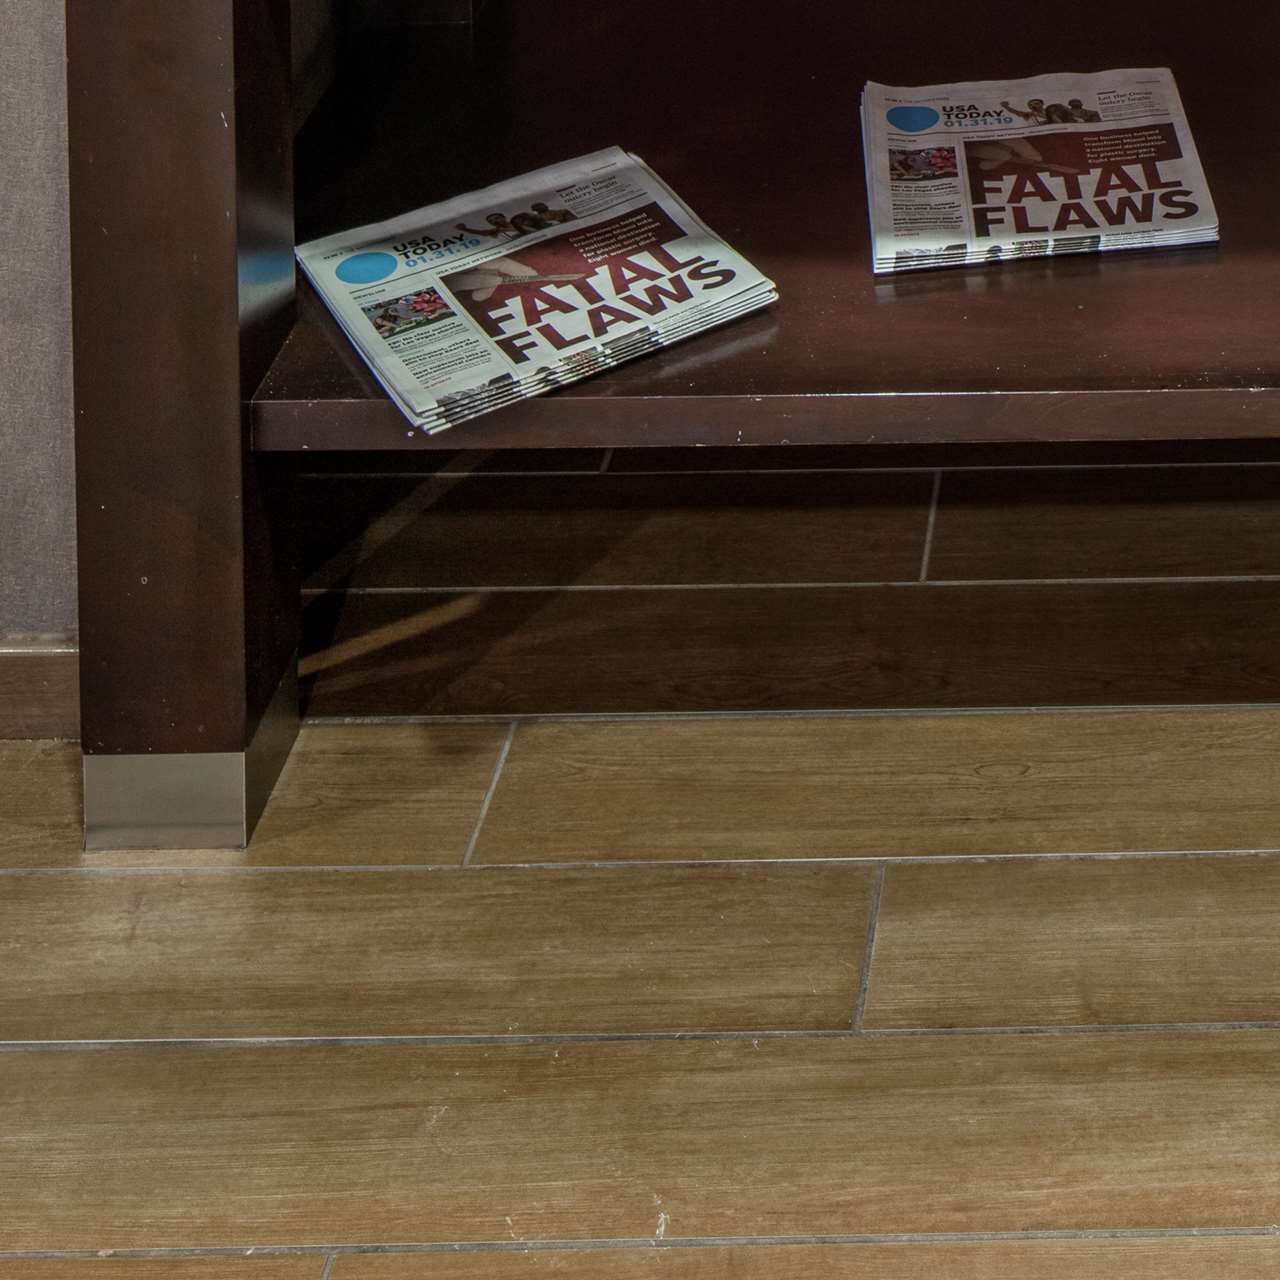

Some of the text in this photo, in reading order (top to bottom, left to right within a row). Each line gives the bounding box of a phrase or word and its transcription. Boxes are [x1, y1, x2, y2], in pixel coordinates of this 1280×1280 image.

[942, 104, 978, 113] USA
[943, 110, 1003, 120] TODAY
[944, 116, 1013, 128] 01.31.19
[967, 159, 1183, 205] FATAL
[974, 190, 1199, 238] FLAWS
[393, 235, 435, 252] USA
[398, 233, 465, 259] TODAY
[405, 238, 480, 268] 01.31.19
[471, 243, 705, 338] FATAL
[493, 259, 737, 365] FLAWS
